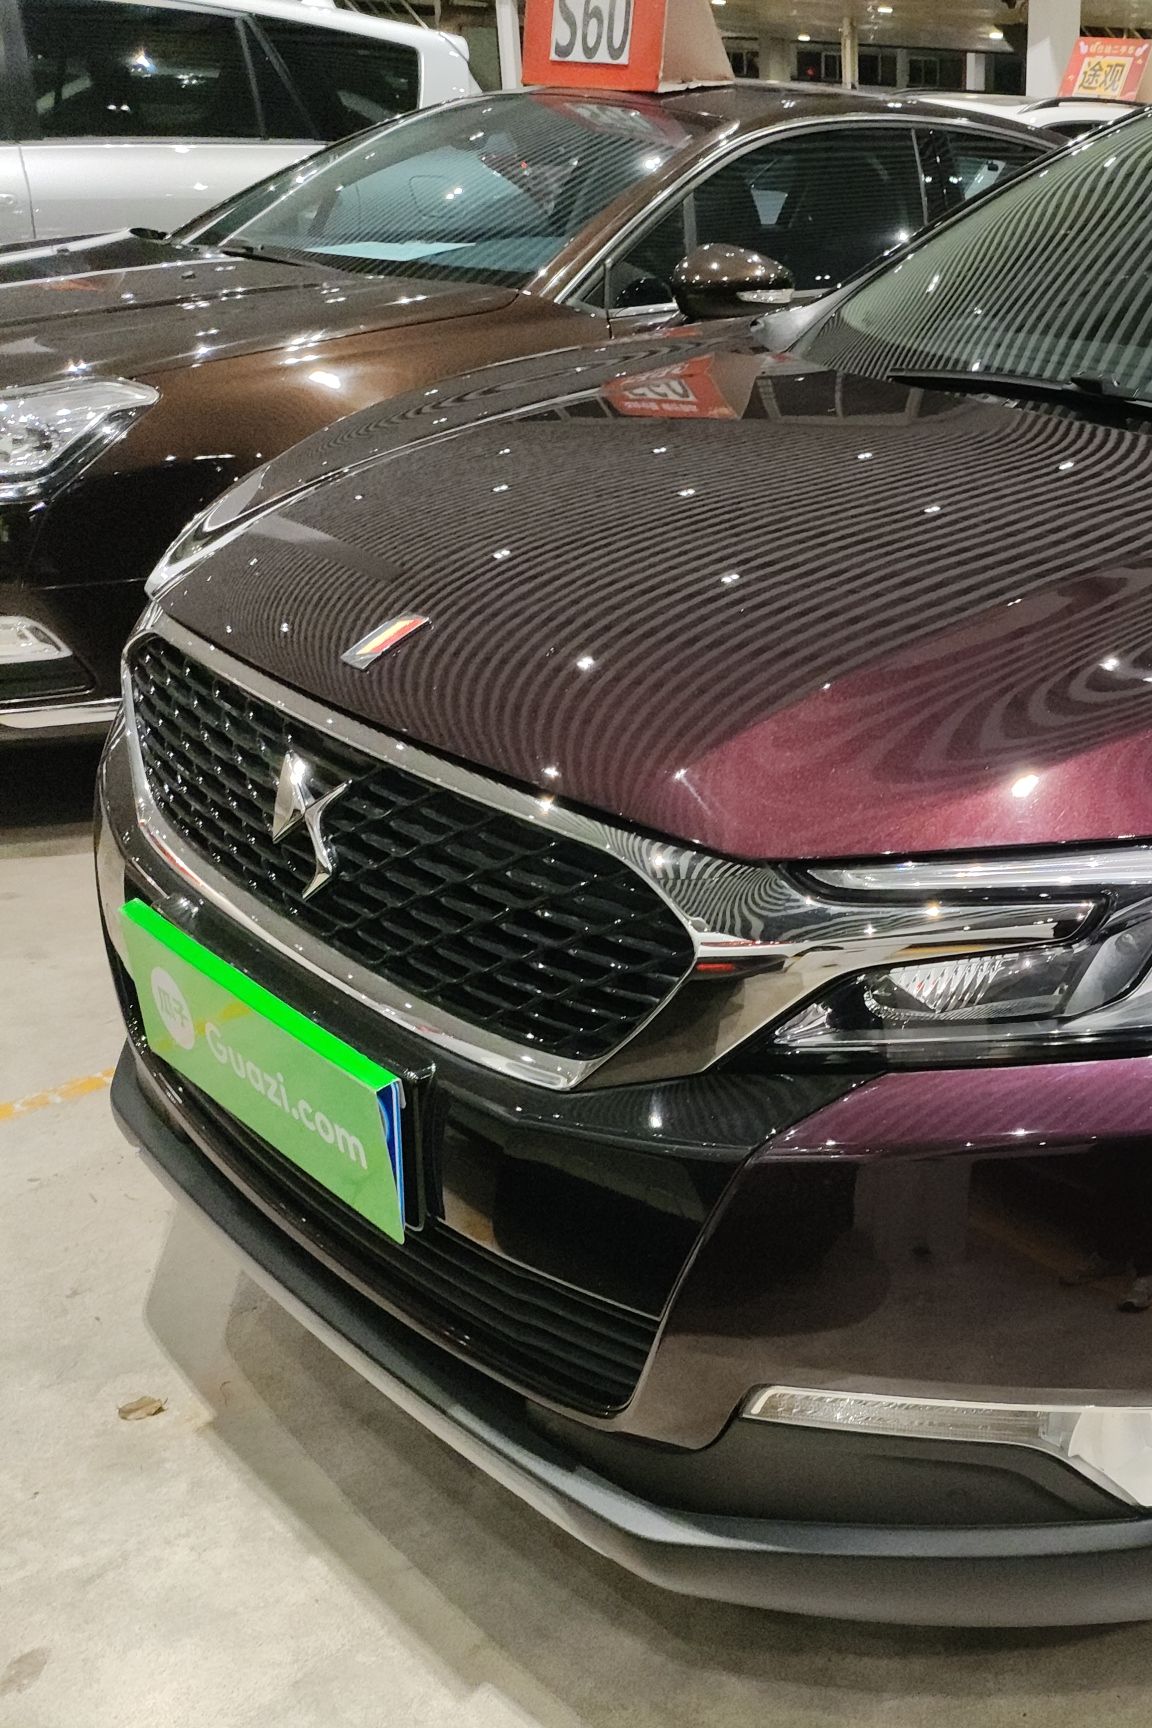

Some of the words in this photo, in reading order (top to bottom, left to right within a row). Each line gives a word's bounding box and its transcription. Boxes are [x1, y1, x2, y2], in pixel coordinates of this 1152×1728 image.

[554, 0, 630, 60] S60
[1079, 61, 1125, 92] 途观
[205, 1021, 368, 1170] Guazi.com
